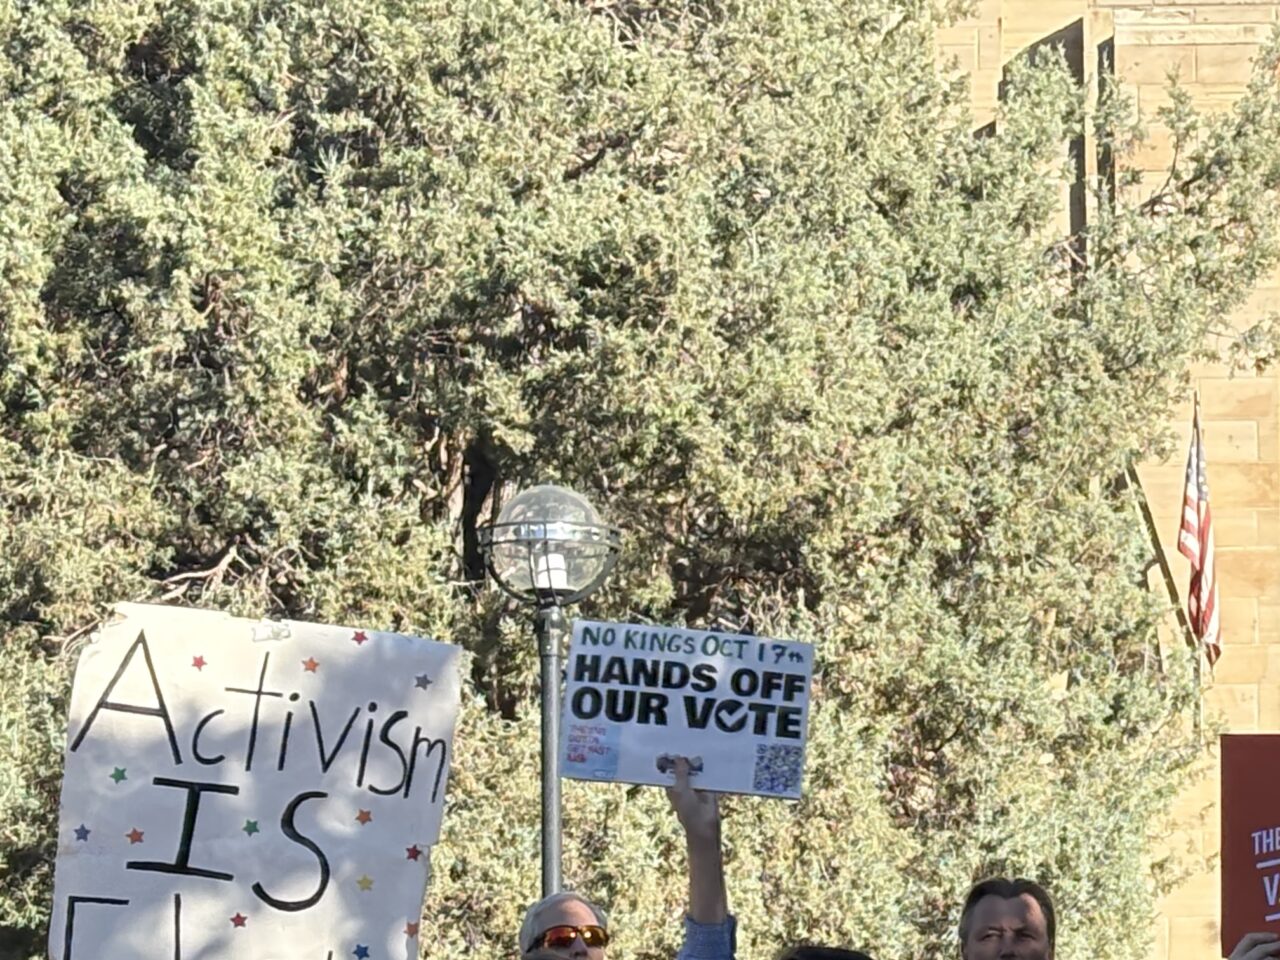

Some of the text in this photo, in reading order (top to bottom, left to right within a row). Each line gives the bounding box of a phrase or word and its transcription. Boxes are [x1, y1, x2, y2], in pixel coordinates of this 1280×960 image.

[582, 627, 615, 646] NO
[625, 630, 695, 654] KINGS
[702, 635, 748, 659] OCT
[574, 655, 806, 702] HANDS OFF
[71, 629, 446, 803] Activism
[571, 687, 802, 739] OUR VOTE
[126, 777, 331, 911] IS
